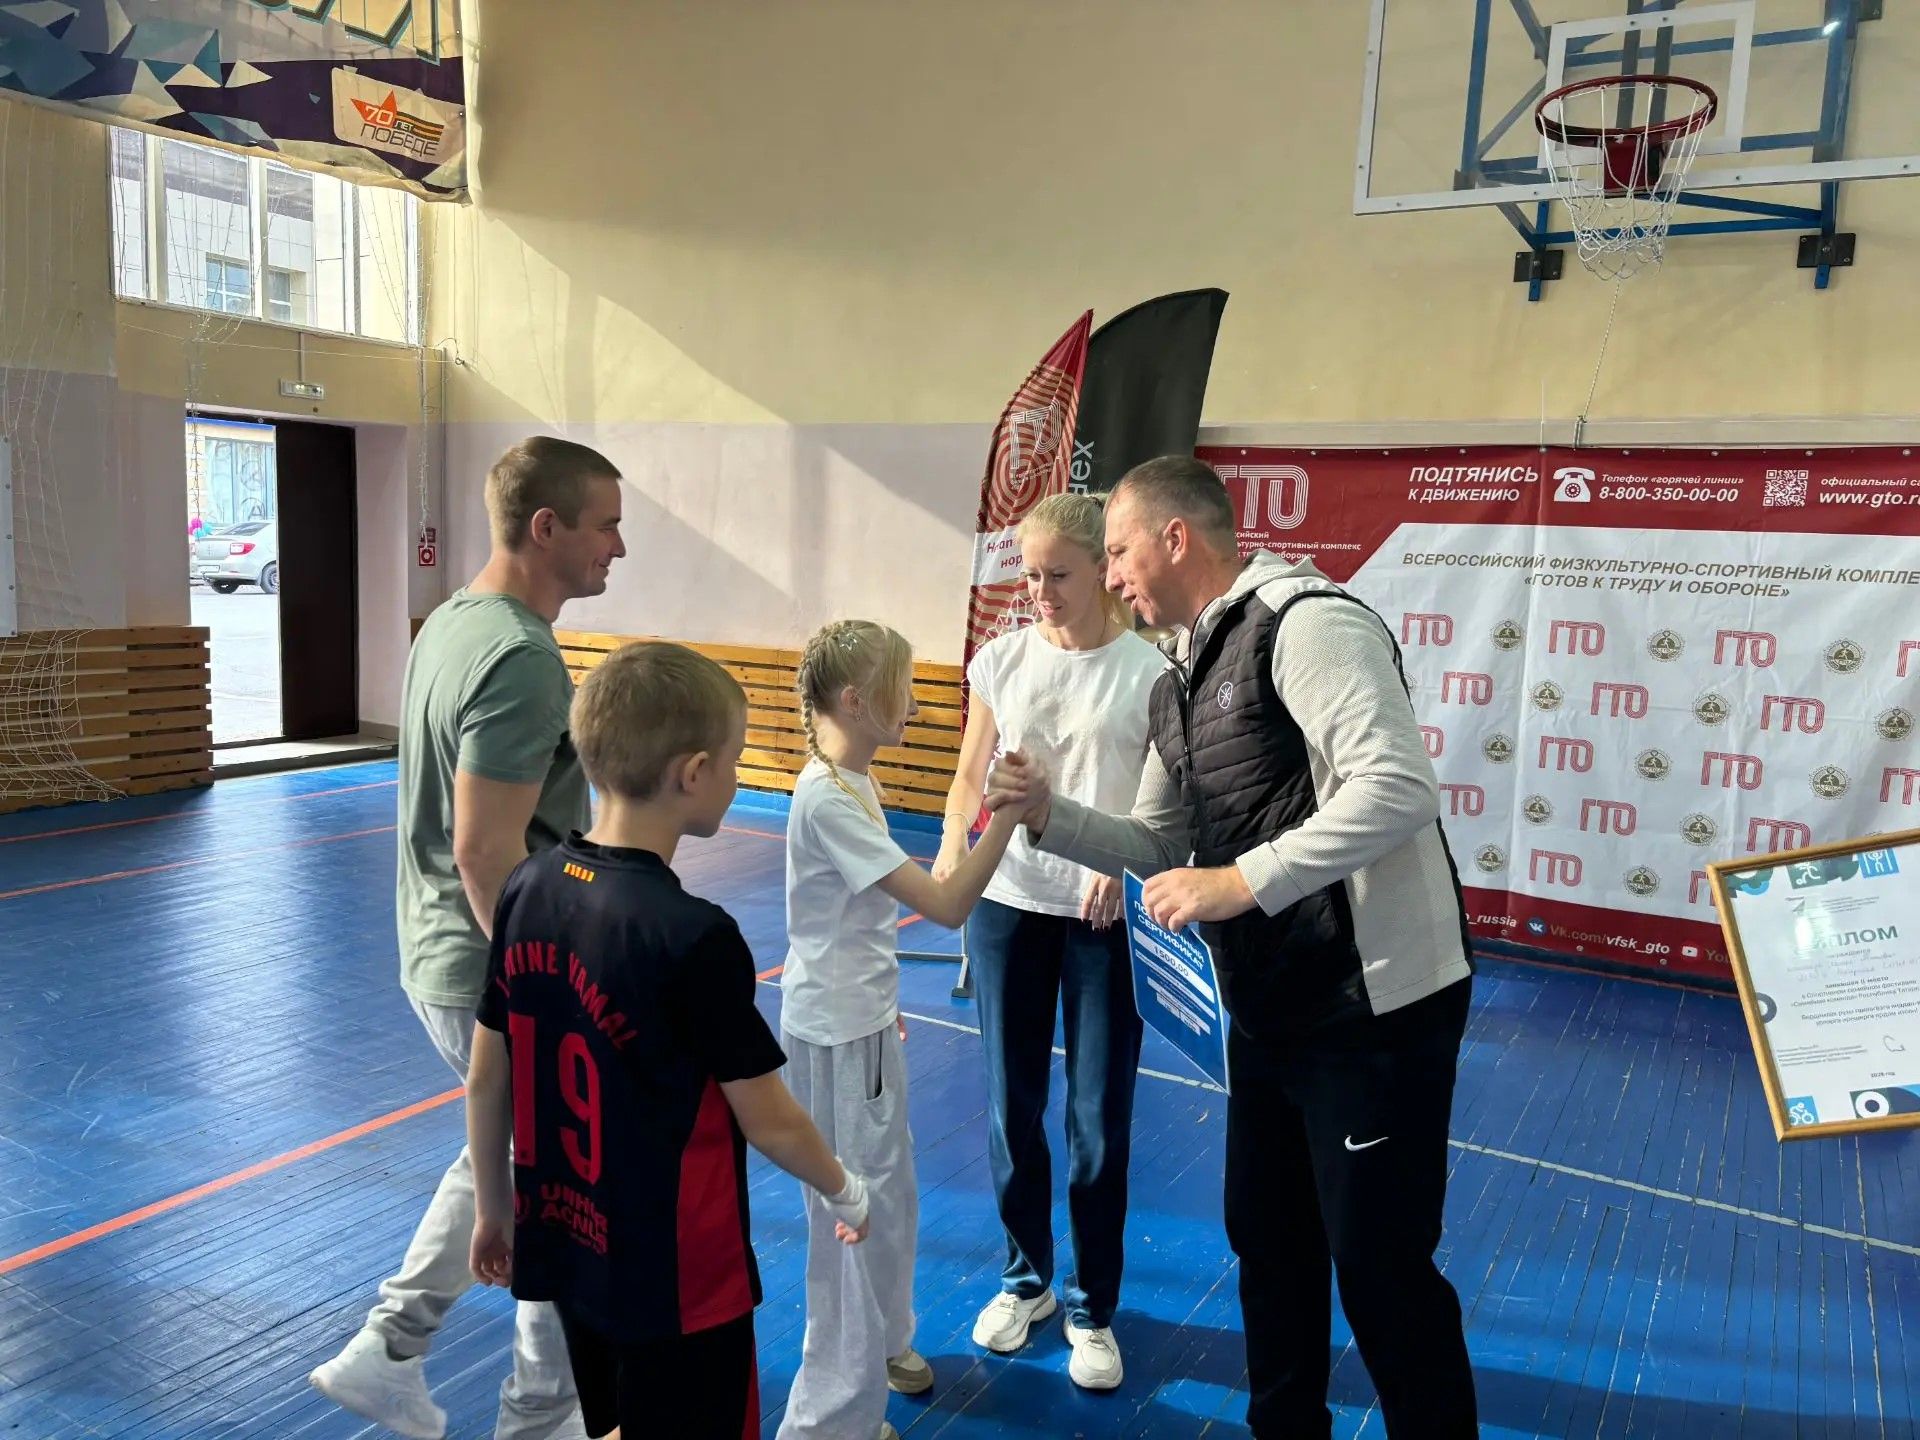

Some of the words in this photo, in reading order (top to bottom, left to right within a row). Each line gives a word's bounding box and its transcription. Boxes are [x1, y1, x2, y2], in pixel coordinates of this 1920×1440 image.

[365, 106, 393, 124] 70
[360, 123, 439, 157] ПОБЕДЕ
[1409, 466, 1539, 483] ПОДТЯНИСЬ
[1602, 474, 1648, 485] Телефон
[1651, 475, 1700, 484] «горячей
[1703, 477, 1744, 485] линии»
[1820, 477, 1907, 487] официальный
[1408, 489, 1419, 500] К
[1420, 488, 1520, 503] ДВИЖЕНИЮ
[1599, 487, 1739, 502] 8-800-350-00-00
[1234, 531, 1270, 539] сийский
[1320, 543, 1362, 551] комплекс
[1402, 553, 1546, 568] ВСЕРОССИЙСКИЙ
[1550, 557, 1833, 581] ФИЗКУЛЬТУРНО-СПОРТИВНЫЙ
[1524, 574, 1588, 588] «ГОТОВ
[1593, 577, 1606, 589] К
[1609, 578, 1666, 594] ТРУДУ
[1669, 581, 1683, 592] И
[1687, 581, 1790, 597] ОБОРОНЕ»
[1401, 612, 1454, 646] ГТО
[1549, 620, 1606, 656] ГТО
[1714, 630, 1777, 668] ГТО
[1440, 672, 1494, 706] ГТО
[1590, 682, 1649, 719] ГТО
[1760, 695, 1825, 734] ГТО
[1538, 736, 1594, 773] ГТО
[1700, 751, 1763, 790] ГТО
[1879, 768, 1920, 805] ГТ
[1580, 798, 1638, 836] ГТО
[1529, 848, 1583, 888] ГТО
[1137, 914, 1203, 970] СЕРТИФИКАТ
[1153, 946, 1190, 977] 1500,00
[569, 952, 637, 1050] YAMAL
[508, 1012, 602, 1186] 19
